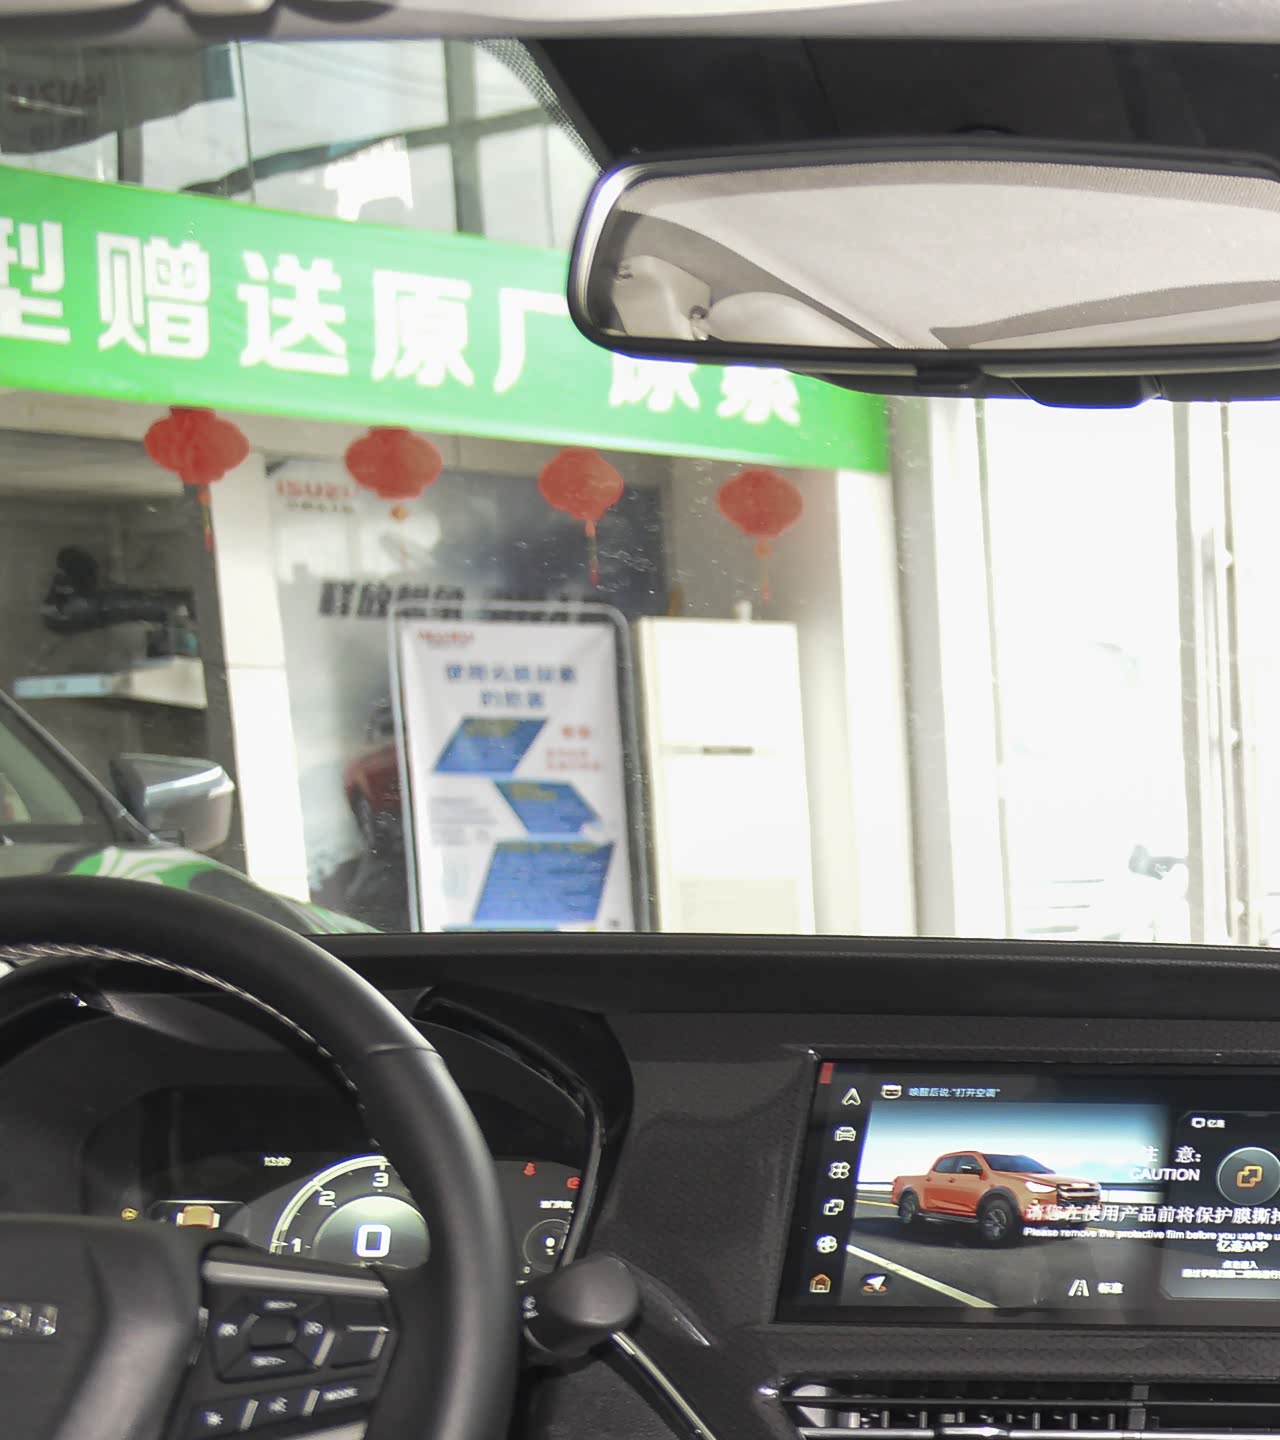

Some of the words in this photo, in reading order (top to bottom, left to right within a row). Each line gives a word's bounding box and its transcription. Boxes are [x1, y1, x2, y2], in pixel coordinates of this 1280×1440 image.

[372, 1172, 389, 1188] 3
[1129, 1167, 1201, 1182] CAUTION
[318, 1190, 336, 1206] 2
[355, 1224, 392, 1258] 0
[1023, 1226, 1060, 1238] Please
[1060, 1228, 1098, 1239] remove
[1100, 1229, 1114, 1239] the
[1115, 1229, 1165, 1240] protective
[1166, 1229, 1185, 1240] film
[1185, 1230, 1217, 1240] before
[1217, 1232, 1237, 1242] you
[1237, 1232, 1256, 1241] use
[1256, 1231, 1273, 1241] the
[290, 1238, 302, 1253] 1
